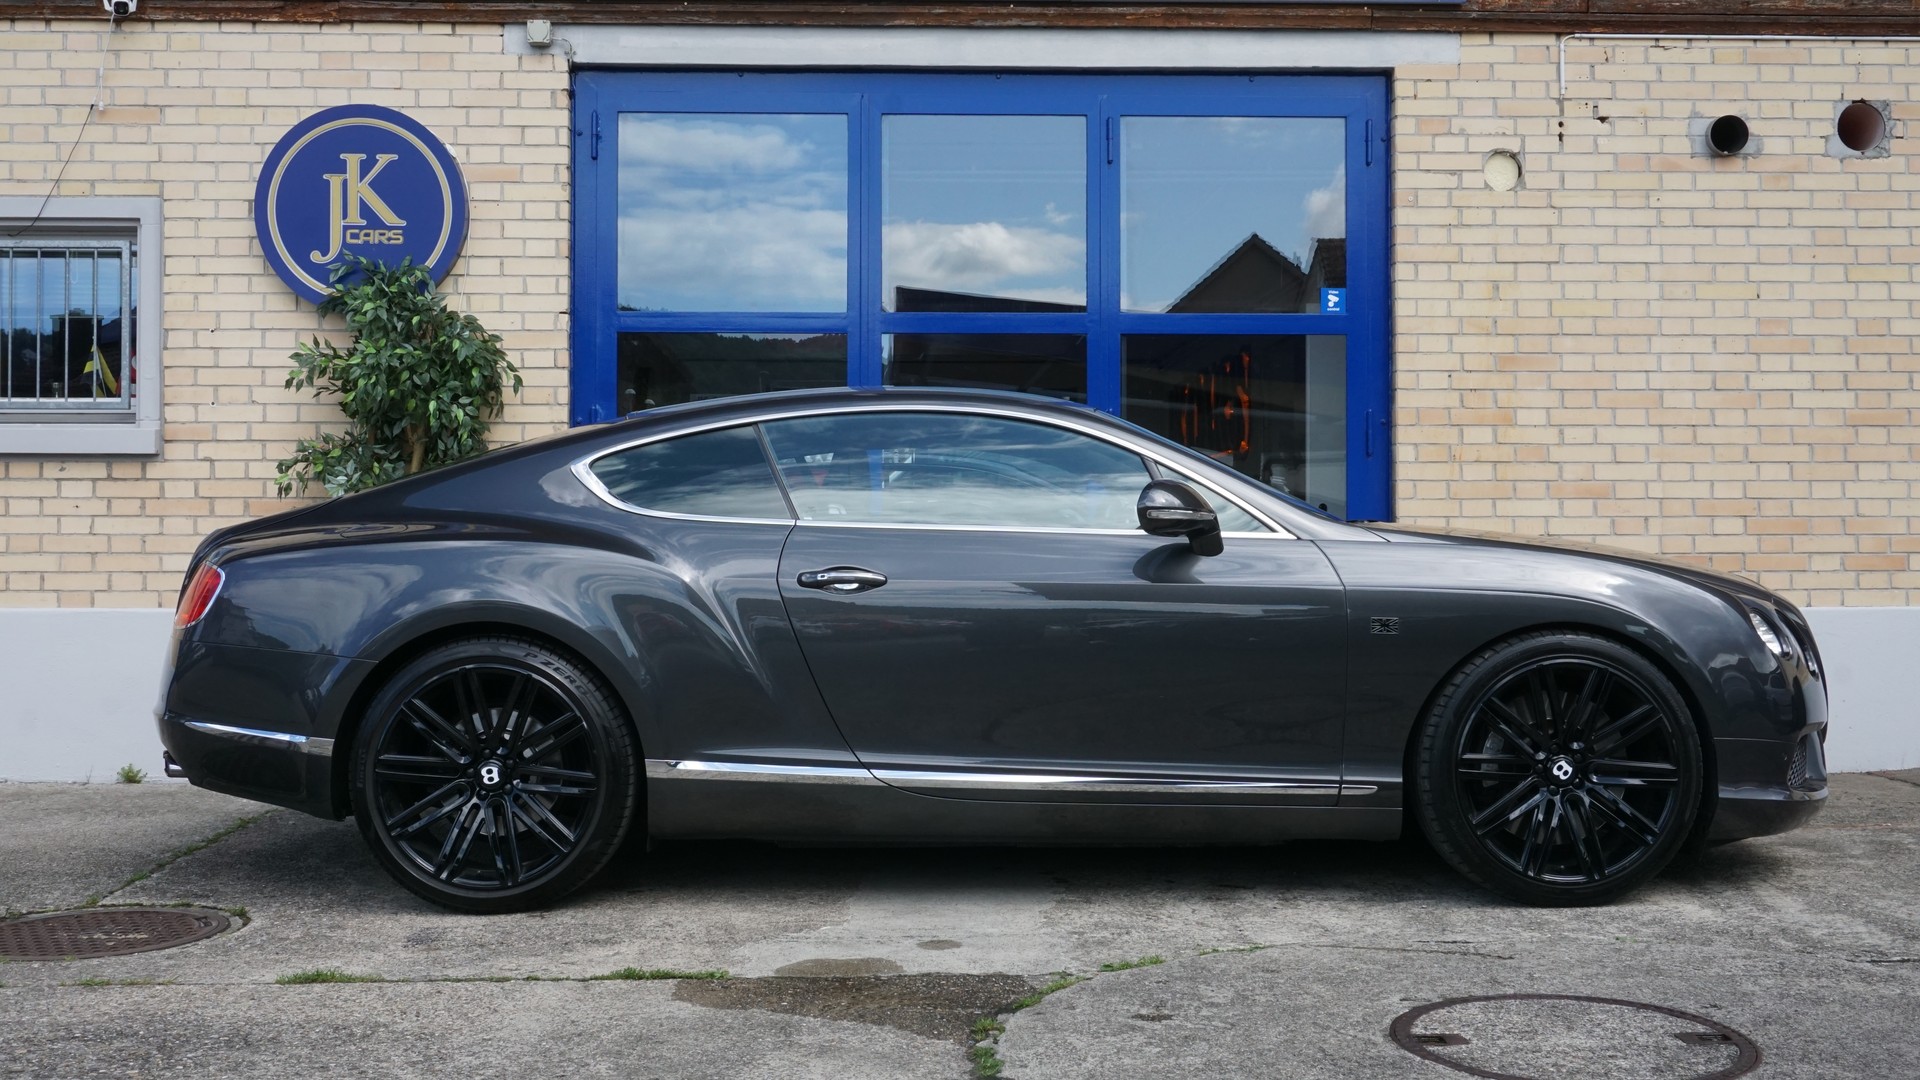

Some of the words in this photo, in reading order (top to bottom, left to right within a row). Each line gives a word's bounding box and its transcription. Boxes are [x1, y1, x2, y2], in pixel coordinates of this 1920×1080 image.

[309, 153, 407, 264] JK
[345, 229, 404, 245] CARS
[540, 659, 589, 696] ZERO
